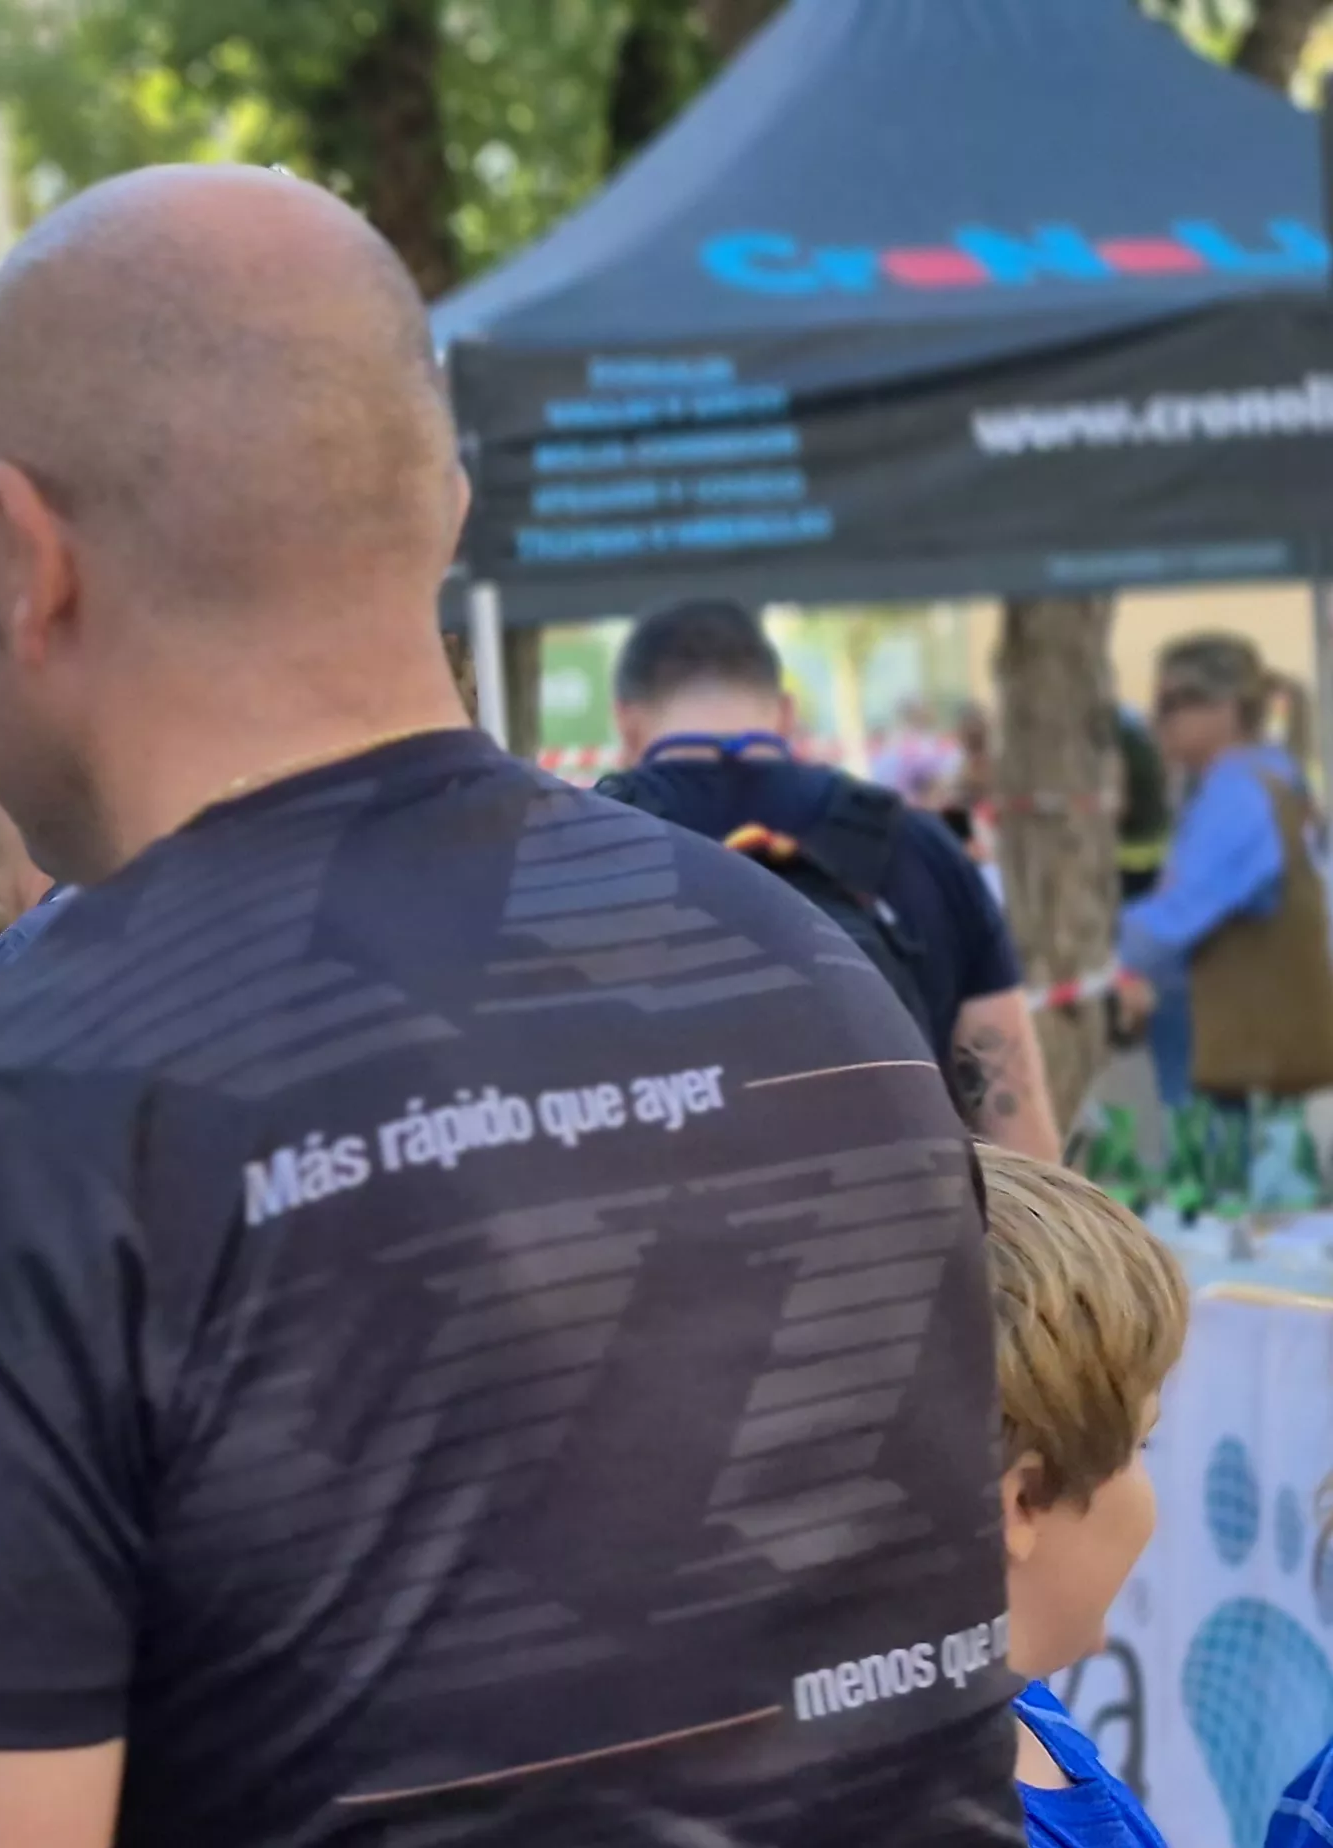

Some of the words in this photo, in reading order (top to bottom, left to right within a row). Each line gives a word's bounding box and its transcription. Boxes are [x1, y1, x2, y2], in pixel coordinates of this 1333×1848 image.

[243, 1132, 371, 1226] Más
[378, 1085, 534, 1171] rápido
[540, 1082, 626, 1147] que
[630, 1064, 724, 1131] ayer
[793, 1641, 937, 1721] menos
[941, 1622, 991, 1689] que
